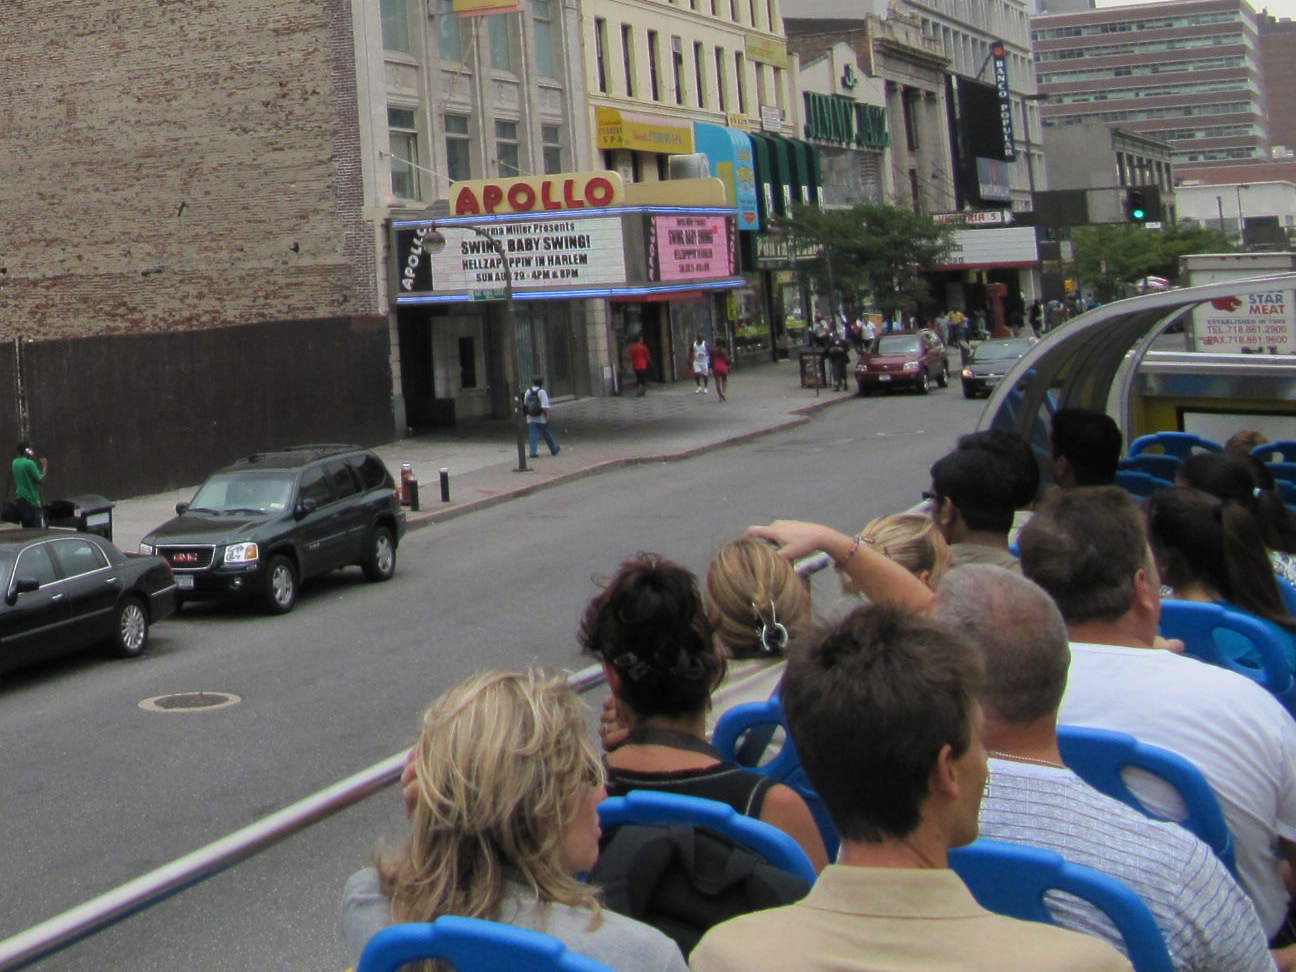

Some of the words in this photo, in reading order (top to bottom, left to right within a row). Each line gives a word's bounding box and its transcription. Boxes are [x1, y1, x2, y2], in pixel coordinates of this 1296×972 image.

[996, 60, 1008, 98] BANCO
[1000, 104, 1014, 156] POPULAR
[456, 177, 614, 216] APOLLO
[505, 224, 532, 234] Miller
[533, 222, 575, 233] Presents
[507, 237, 540, 252] BABY
[543, 234, 591, 250] SWING!
[462, 256, 534, 270] HELLZAPPPIN'
[535, 255, 545, 267] IN
[547, 253, 588, 266] HARLEM
[476, 272, 493, 282] SUN
[495, 271, 512, 281] AU
[514, 270, 525, 280] 29
[531, 269, 551, 280] 4PM
[1249, 293, 1284, 304] STAR
[1249, 304, 1286, 315] MEAT
